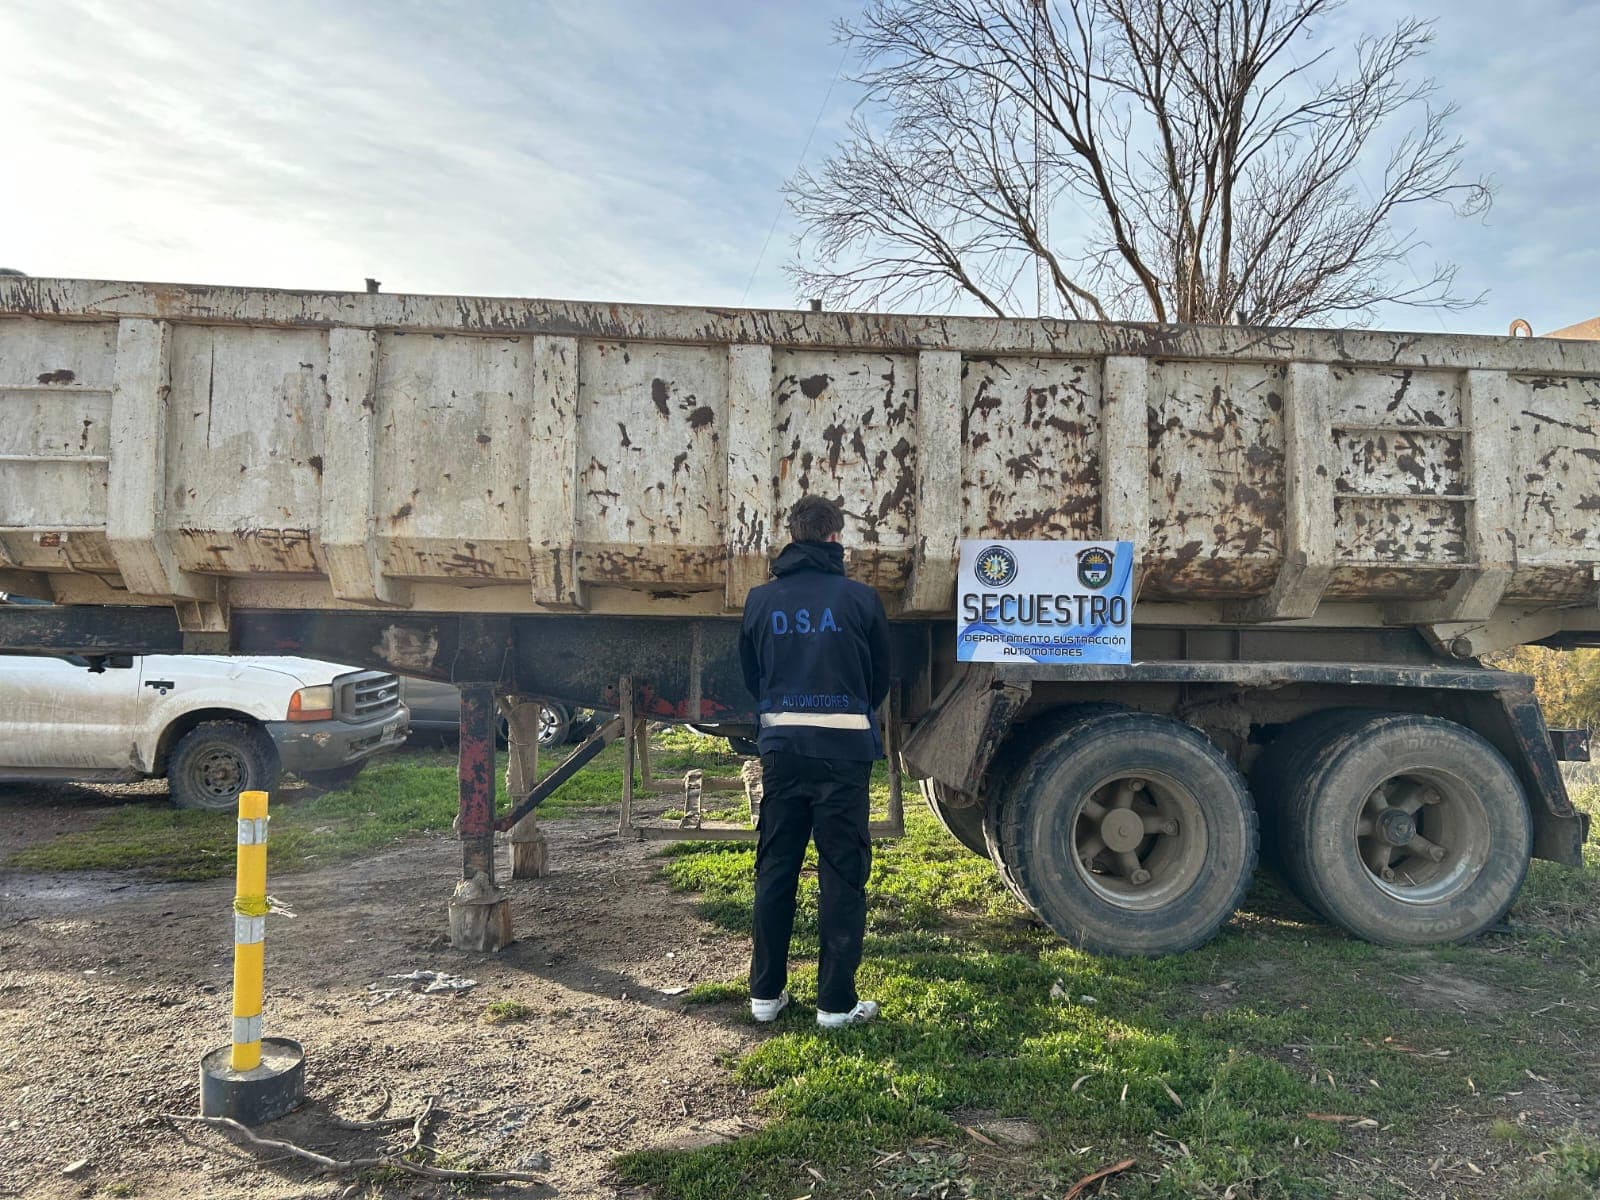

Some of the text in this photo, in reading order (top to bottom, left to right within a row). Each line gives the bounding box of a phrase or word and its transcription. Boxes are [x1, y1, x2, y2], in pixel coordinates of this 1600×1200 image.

[963, 593, 1127, 625] SECUESTRO
[771, 607, 843, 635] D.S.A.
[964, 634, 1050, 644] DEPARTAMENTO
[1003, 647, 1083, 657] AUTOMOTORES
[782, 694, 849, 708] AUTOMOTORES
